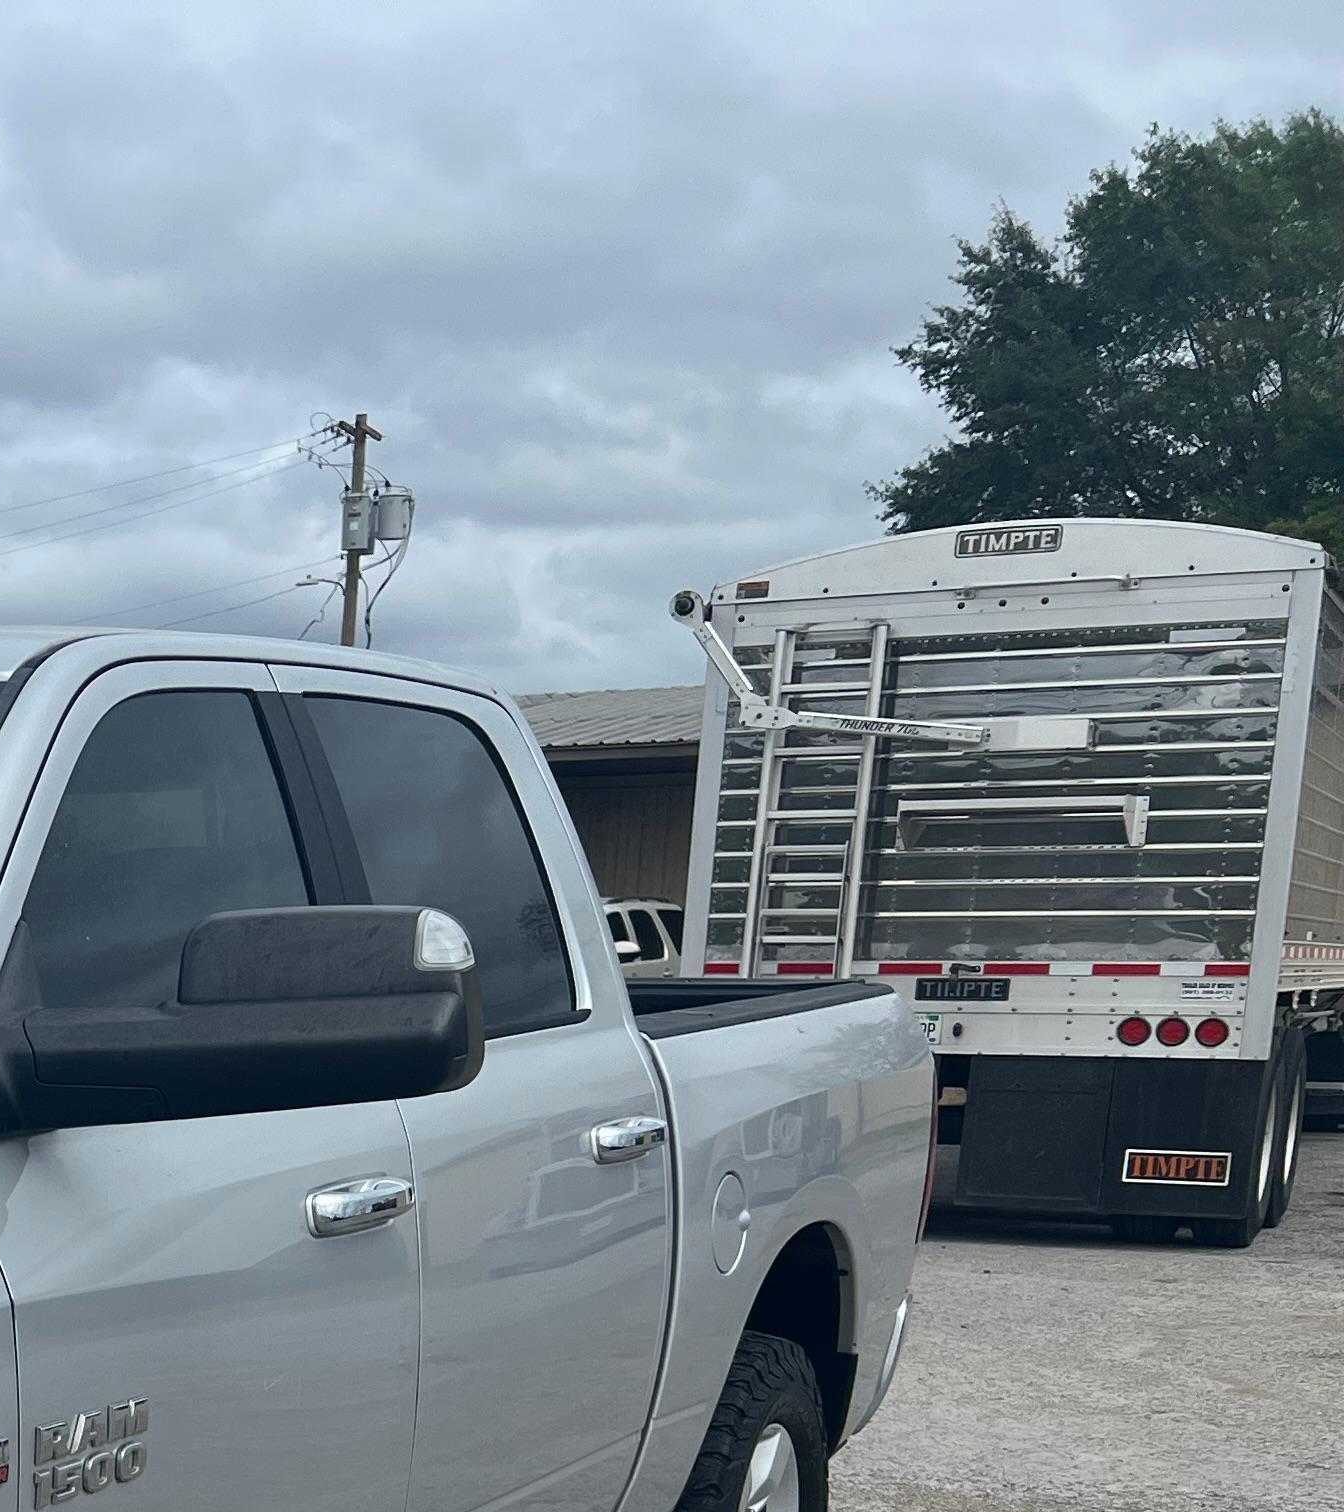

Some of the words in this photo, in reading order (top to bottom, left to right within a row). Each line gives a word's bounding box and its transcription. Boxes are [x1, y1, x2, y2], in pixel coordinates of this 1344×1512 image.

[963, 530, 1056, 553] TIMPTE
[839, 719, 895, 733] THUNDER
[1130, 1154, 1226, 1180] TIMPTE
[33, 1396, 150, 1466] RAM
[33, 1440, 148, 1511] 1500
